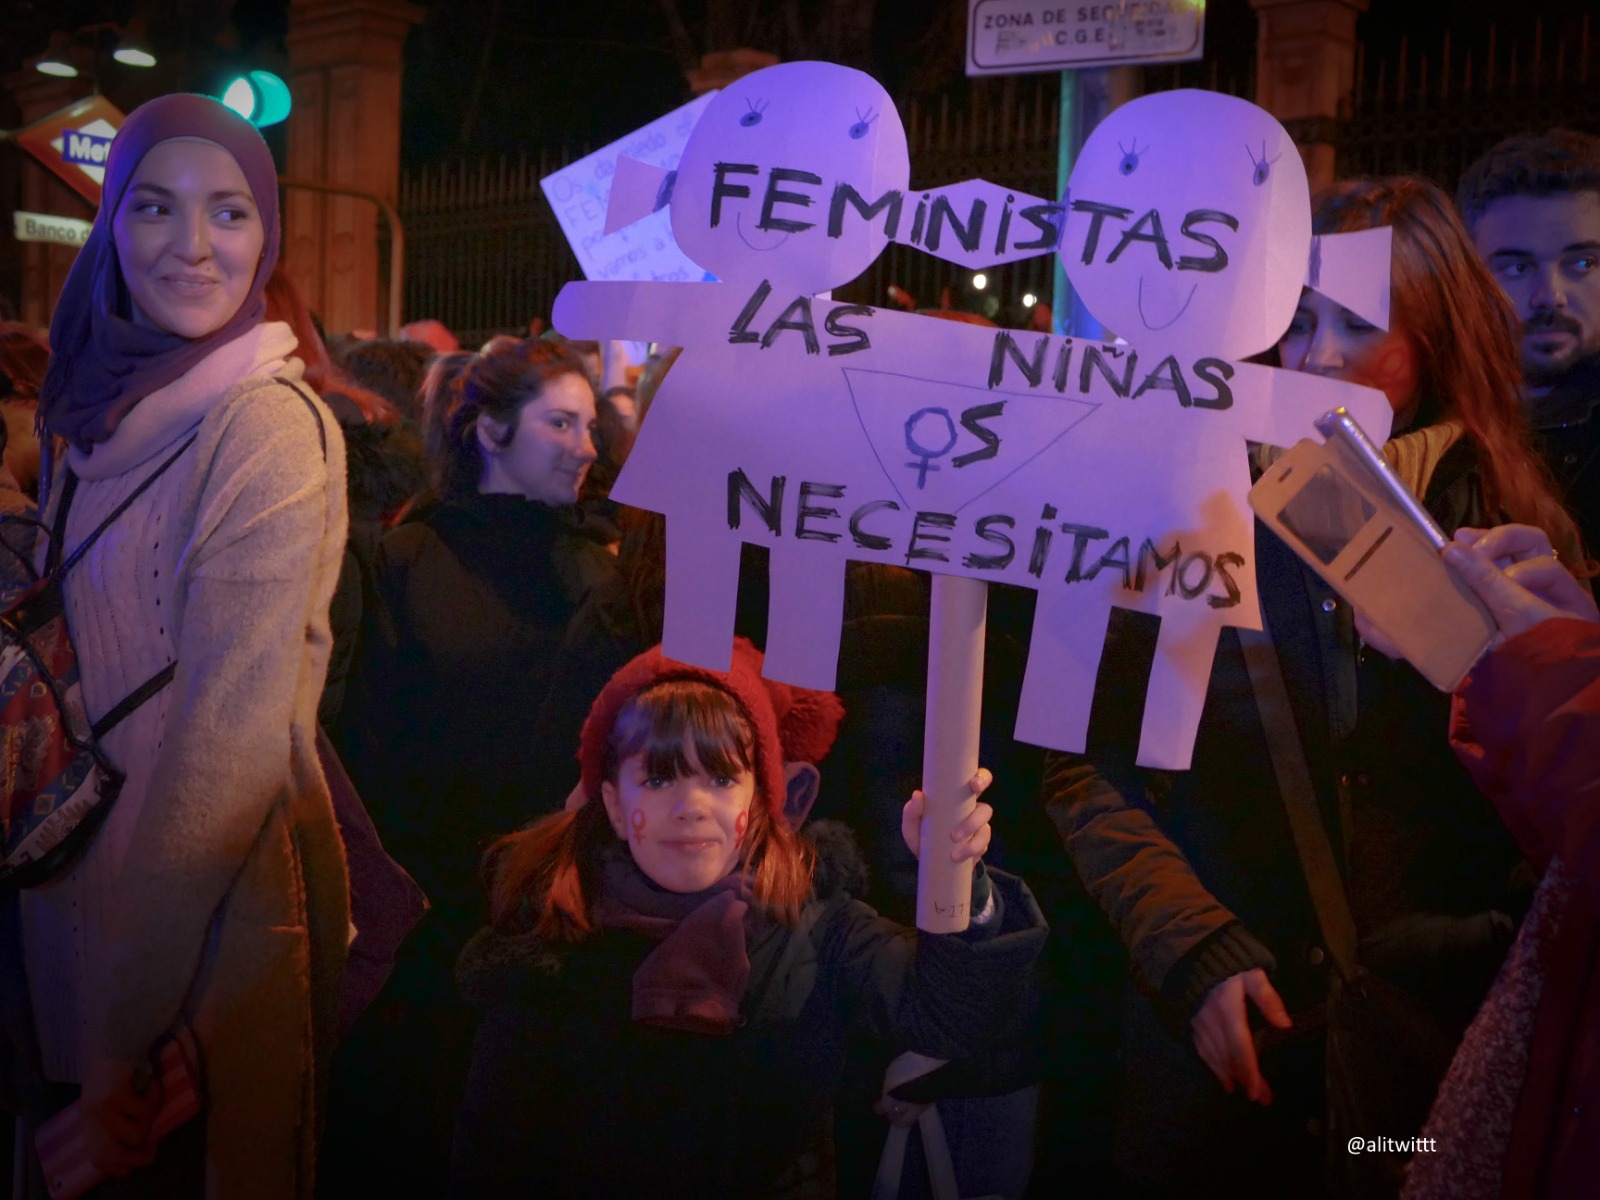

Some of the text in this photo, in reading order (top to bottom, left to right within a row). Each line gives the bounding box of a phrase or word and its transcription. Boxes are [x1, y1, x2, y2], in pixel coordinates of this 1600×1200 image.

[984, 13, 1034, 30] ZONA
[1043, 9, 1067, 24] DE
[25, 219, 77, 241] Banco
[728, 279, 876, 357] LAS
